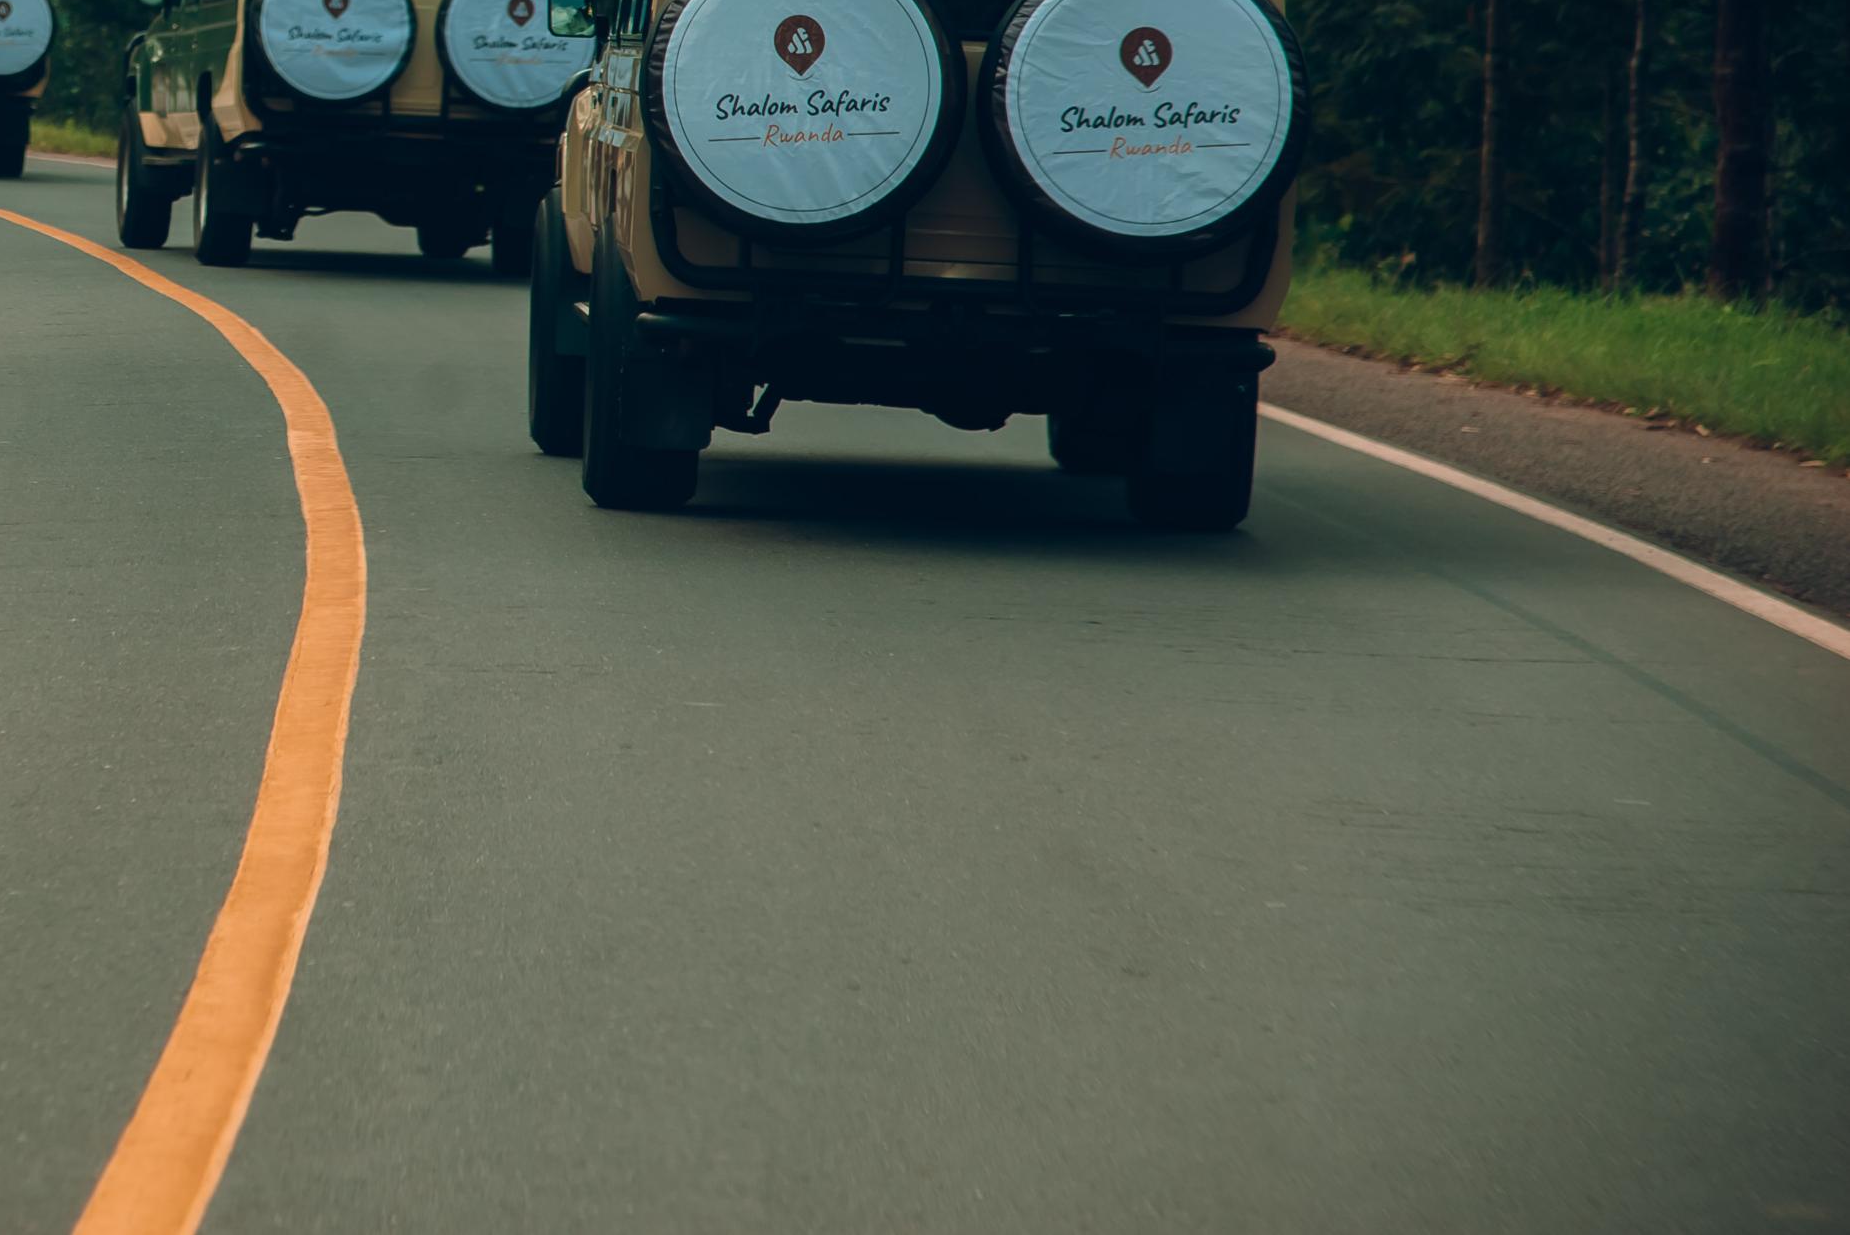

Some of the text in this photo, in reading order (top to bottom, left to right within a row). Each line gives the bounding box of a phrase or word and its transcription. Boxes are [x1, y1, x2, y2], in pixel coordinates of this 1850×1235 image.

[716, 90, 891, 121] Shalom Safaris
[1060, 102, 1241, 133] Shalom Safaris
[763, 123, 845, 147] Rwanda
[1109, 135, 1192, 159] Rwanda
